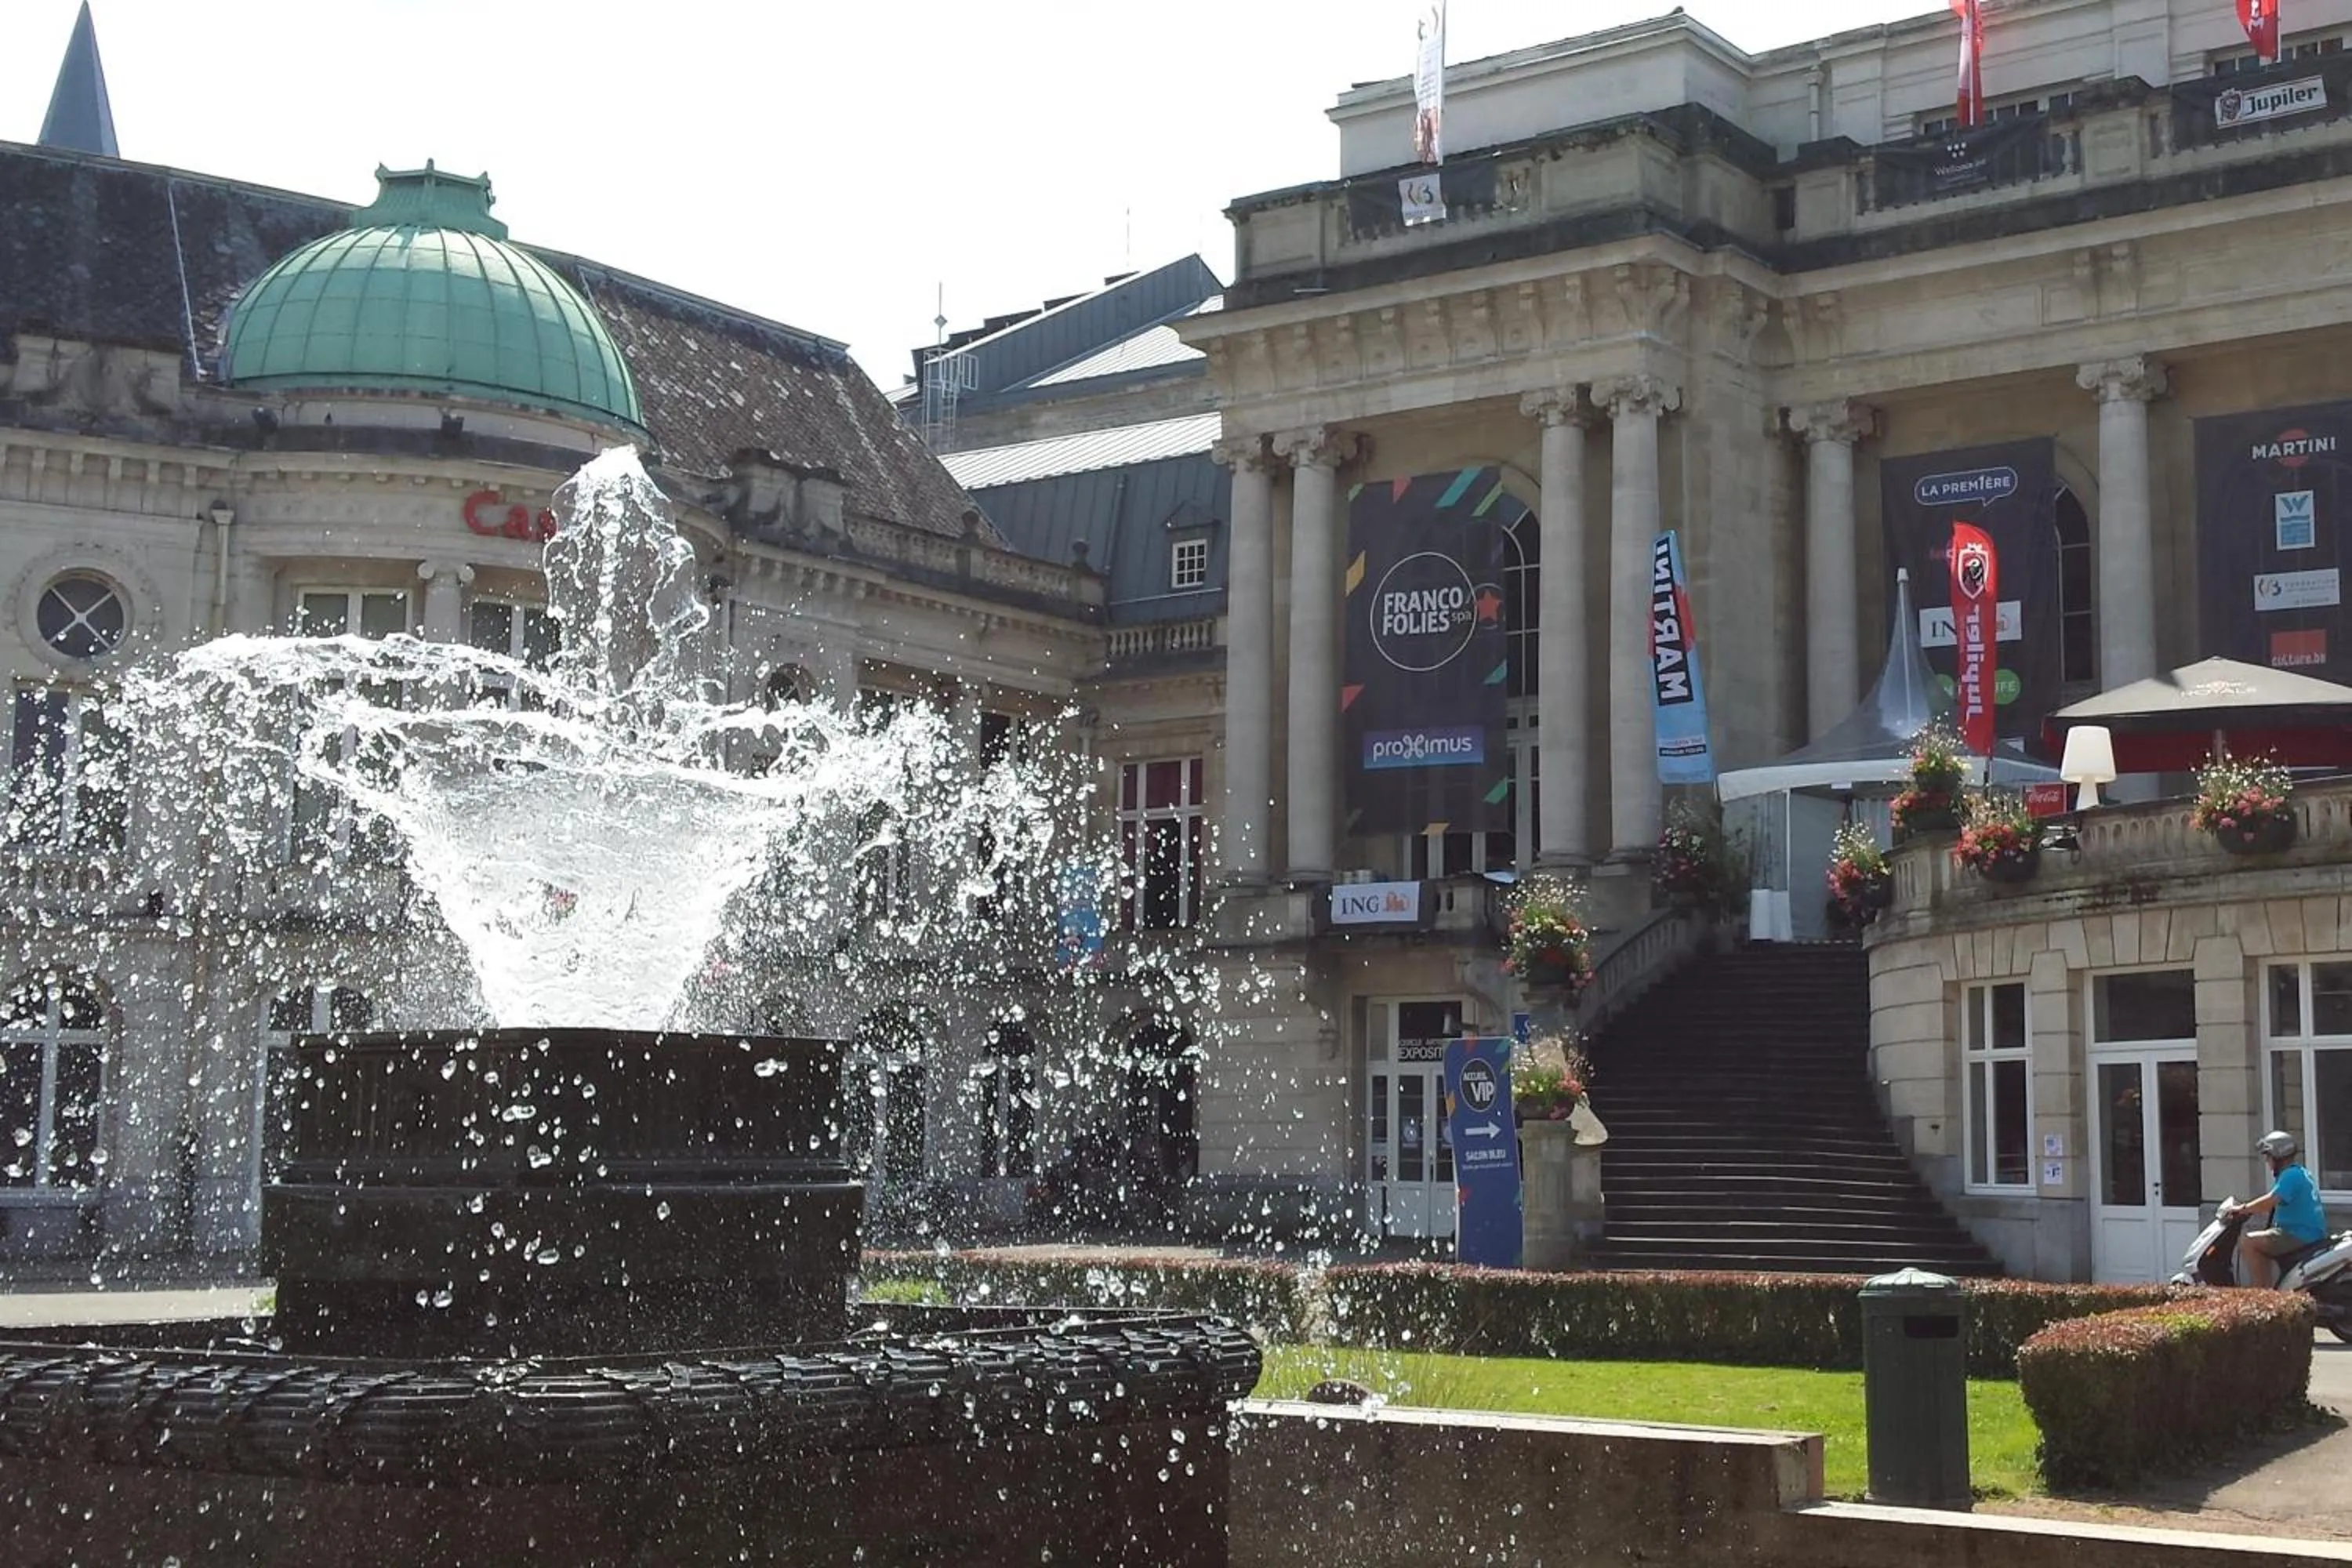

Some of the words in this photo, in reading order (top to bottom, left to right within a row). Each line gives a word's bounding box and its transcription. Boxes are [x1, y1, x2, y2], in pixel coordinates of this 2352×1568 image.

[2245, 87, 2318, 115] Jupiler
[2252, 437, 2336, 460] MARTINI
[1921, 485, 1939, 496] LA
[1384, 586, 1463, 615] FRANCO
[1382, 610, 1450, 636] FOLIES
[1450, 611, 1472, 625] spa
[1341, 895, 1380, 915] ING
[1398, 1047, 1443, 1059] EXPOSIT
[1470, 1081, 1495, 1102] VIP
